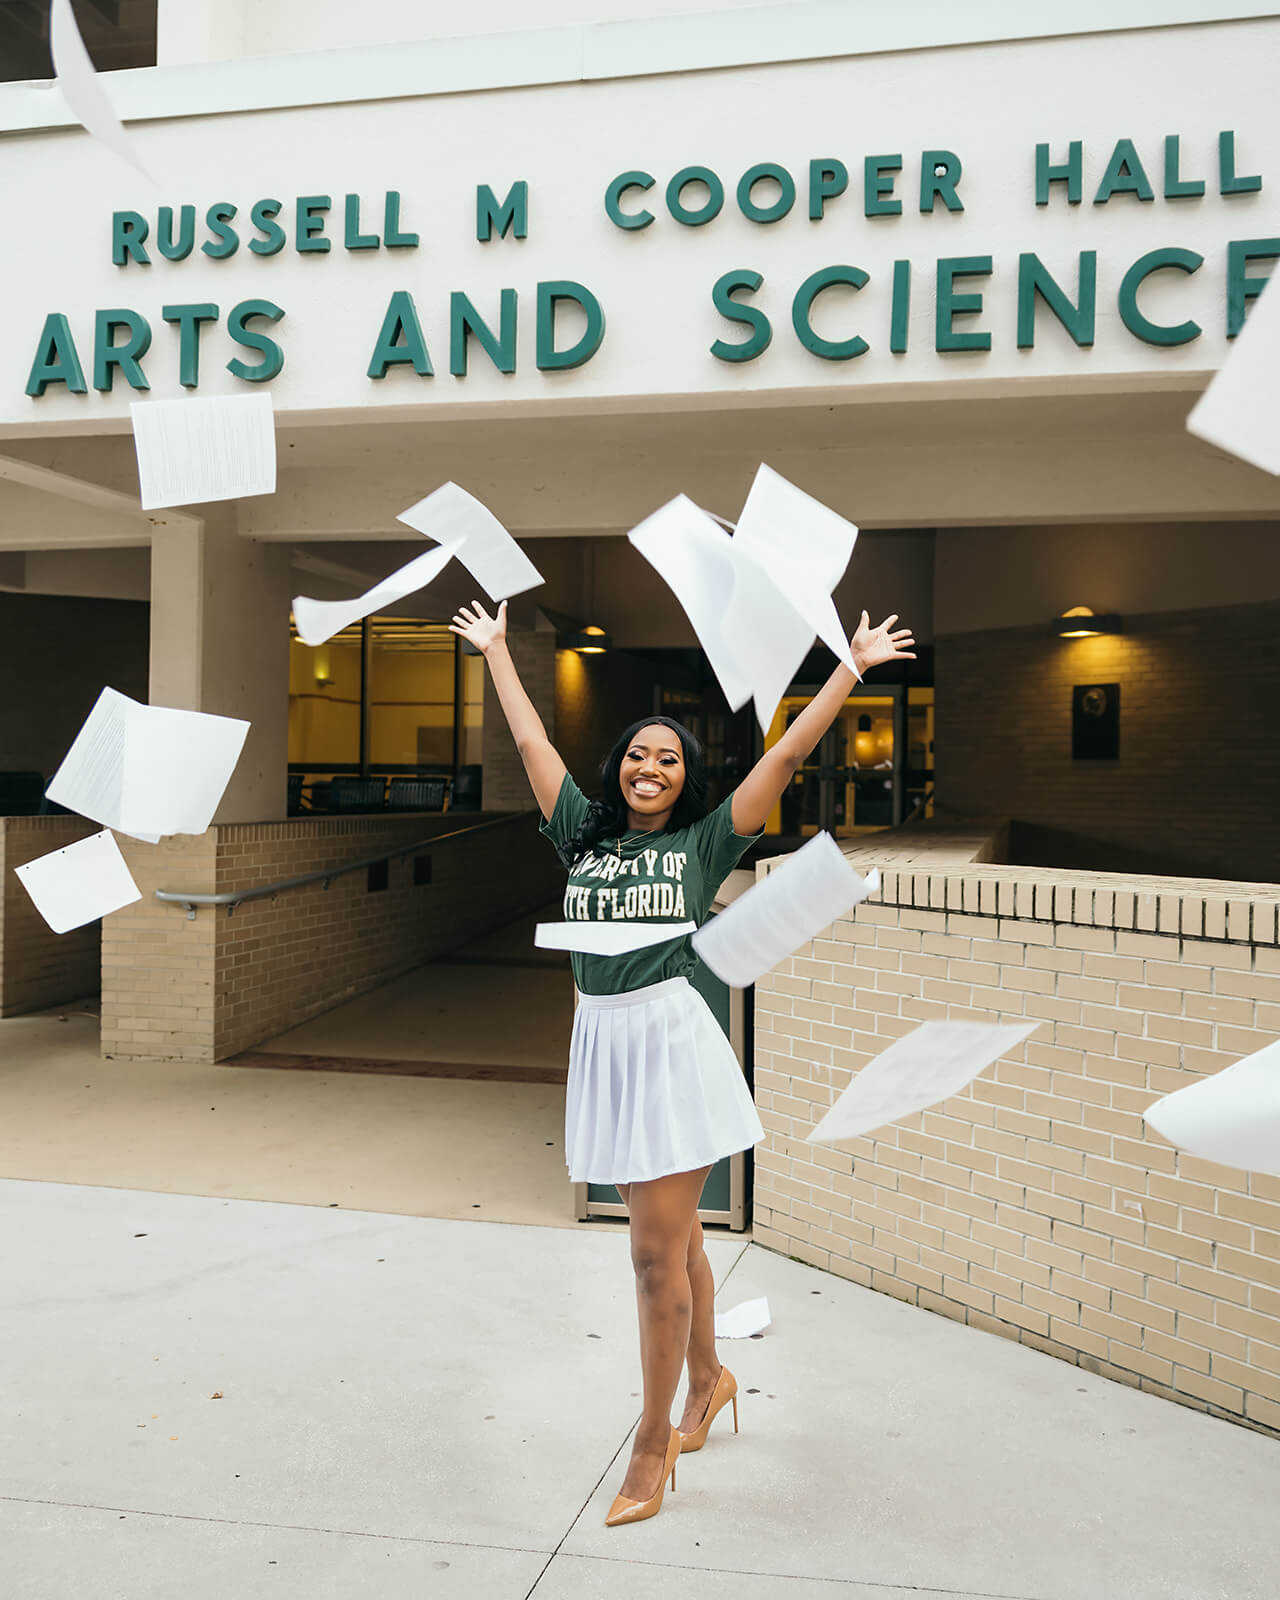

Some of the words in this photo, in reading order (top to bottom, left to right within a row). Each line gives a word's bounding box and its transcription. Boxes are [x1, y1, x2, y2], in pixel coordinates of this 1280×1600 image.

[112, 190, 419, 265] RUSSELL
[476, 180, 528, 242] M
[604, 150, 964, 231] COOPER
[1035, 130, 1262, 206] HALL
[25, 298, 286, 398] ARTS
[367, 280, 606, 380] AND
[597, 882, 686, 920] FLORIDA
[662, 851, 687, 882] OF
